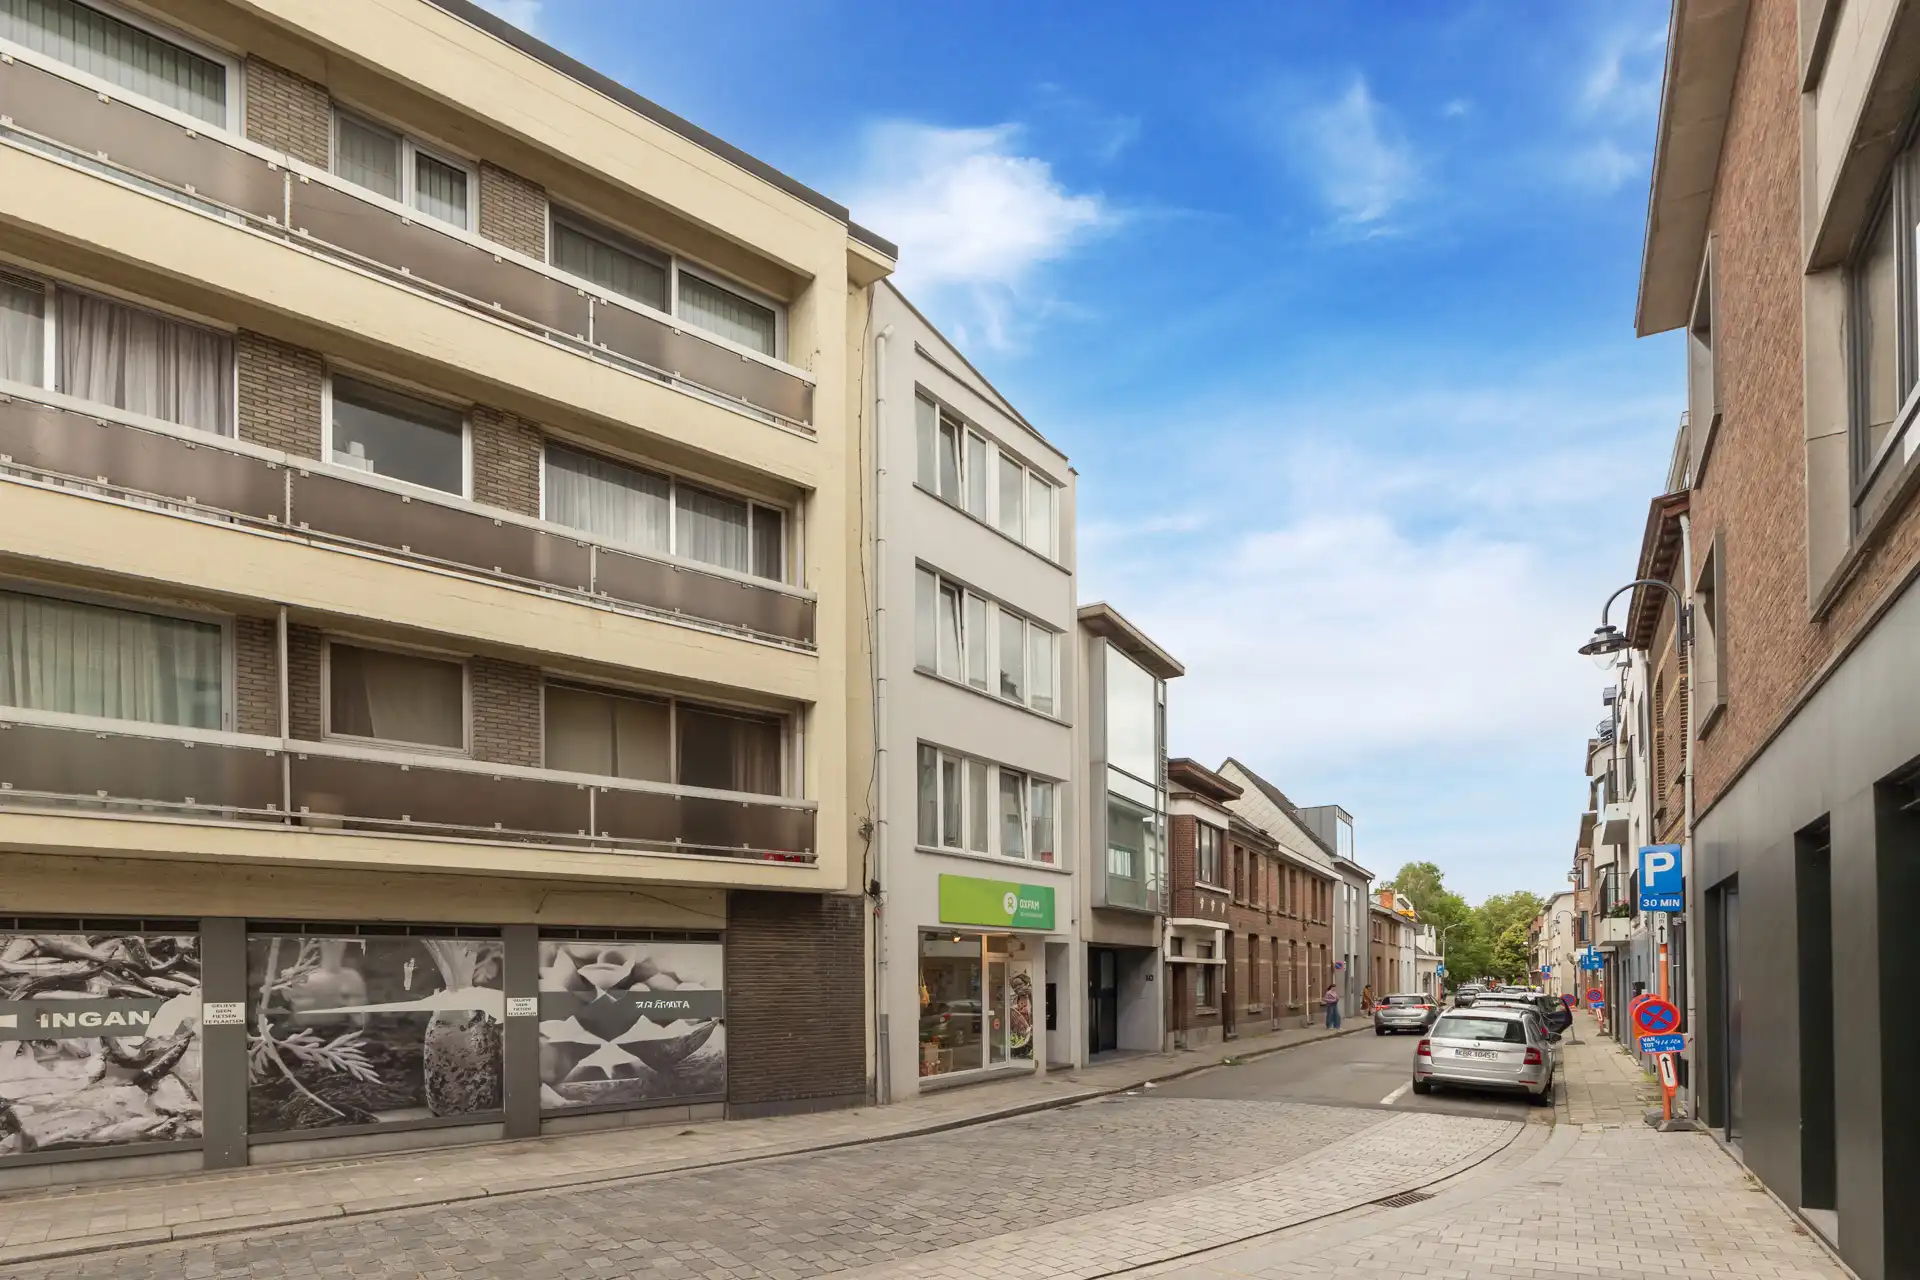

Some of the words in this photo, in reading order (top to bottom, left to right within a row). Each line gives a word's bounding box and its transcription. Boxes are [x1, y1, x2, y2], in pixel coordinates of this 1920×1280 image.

[1644, 852, 1675, 887] P
[1020, 899, 1040, 910] OXFAM
[1643, 899, 1657, 907] 30
[1660, 898, 1680, 907] MIN
